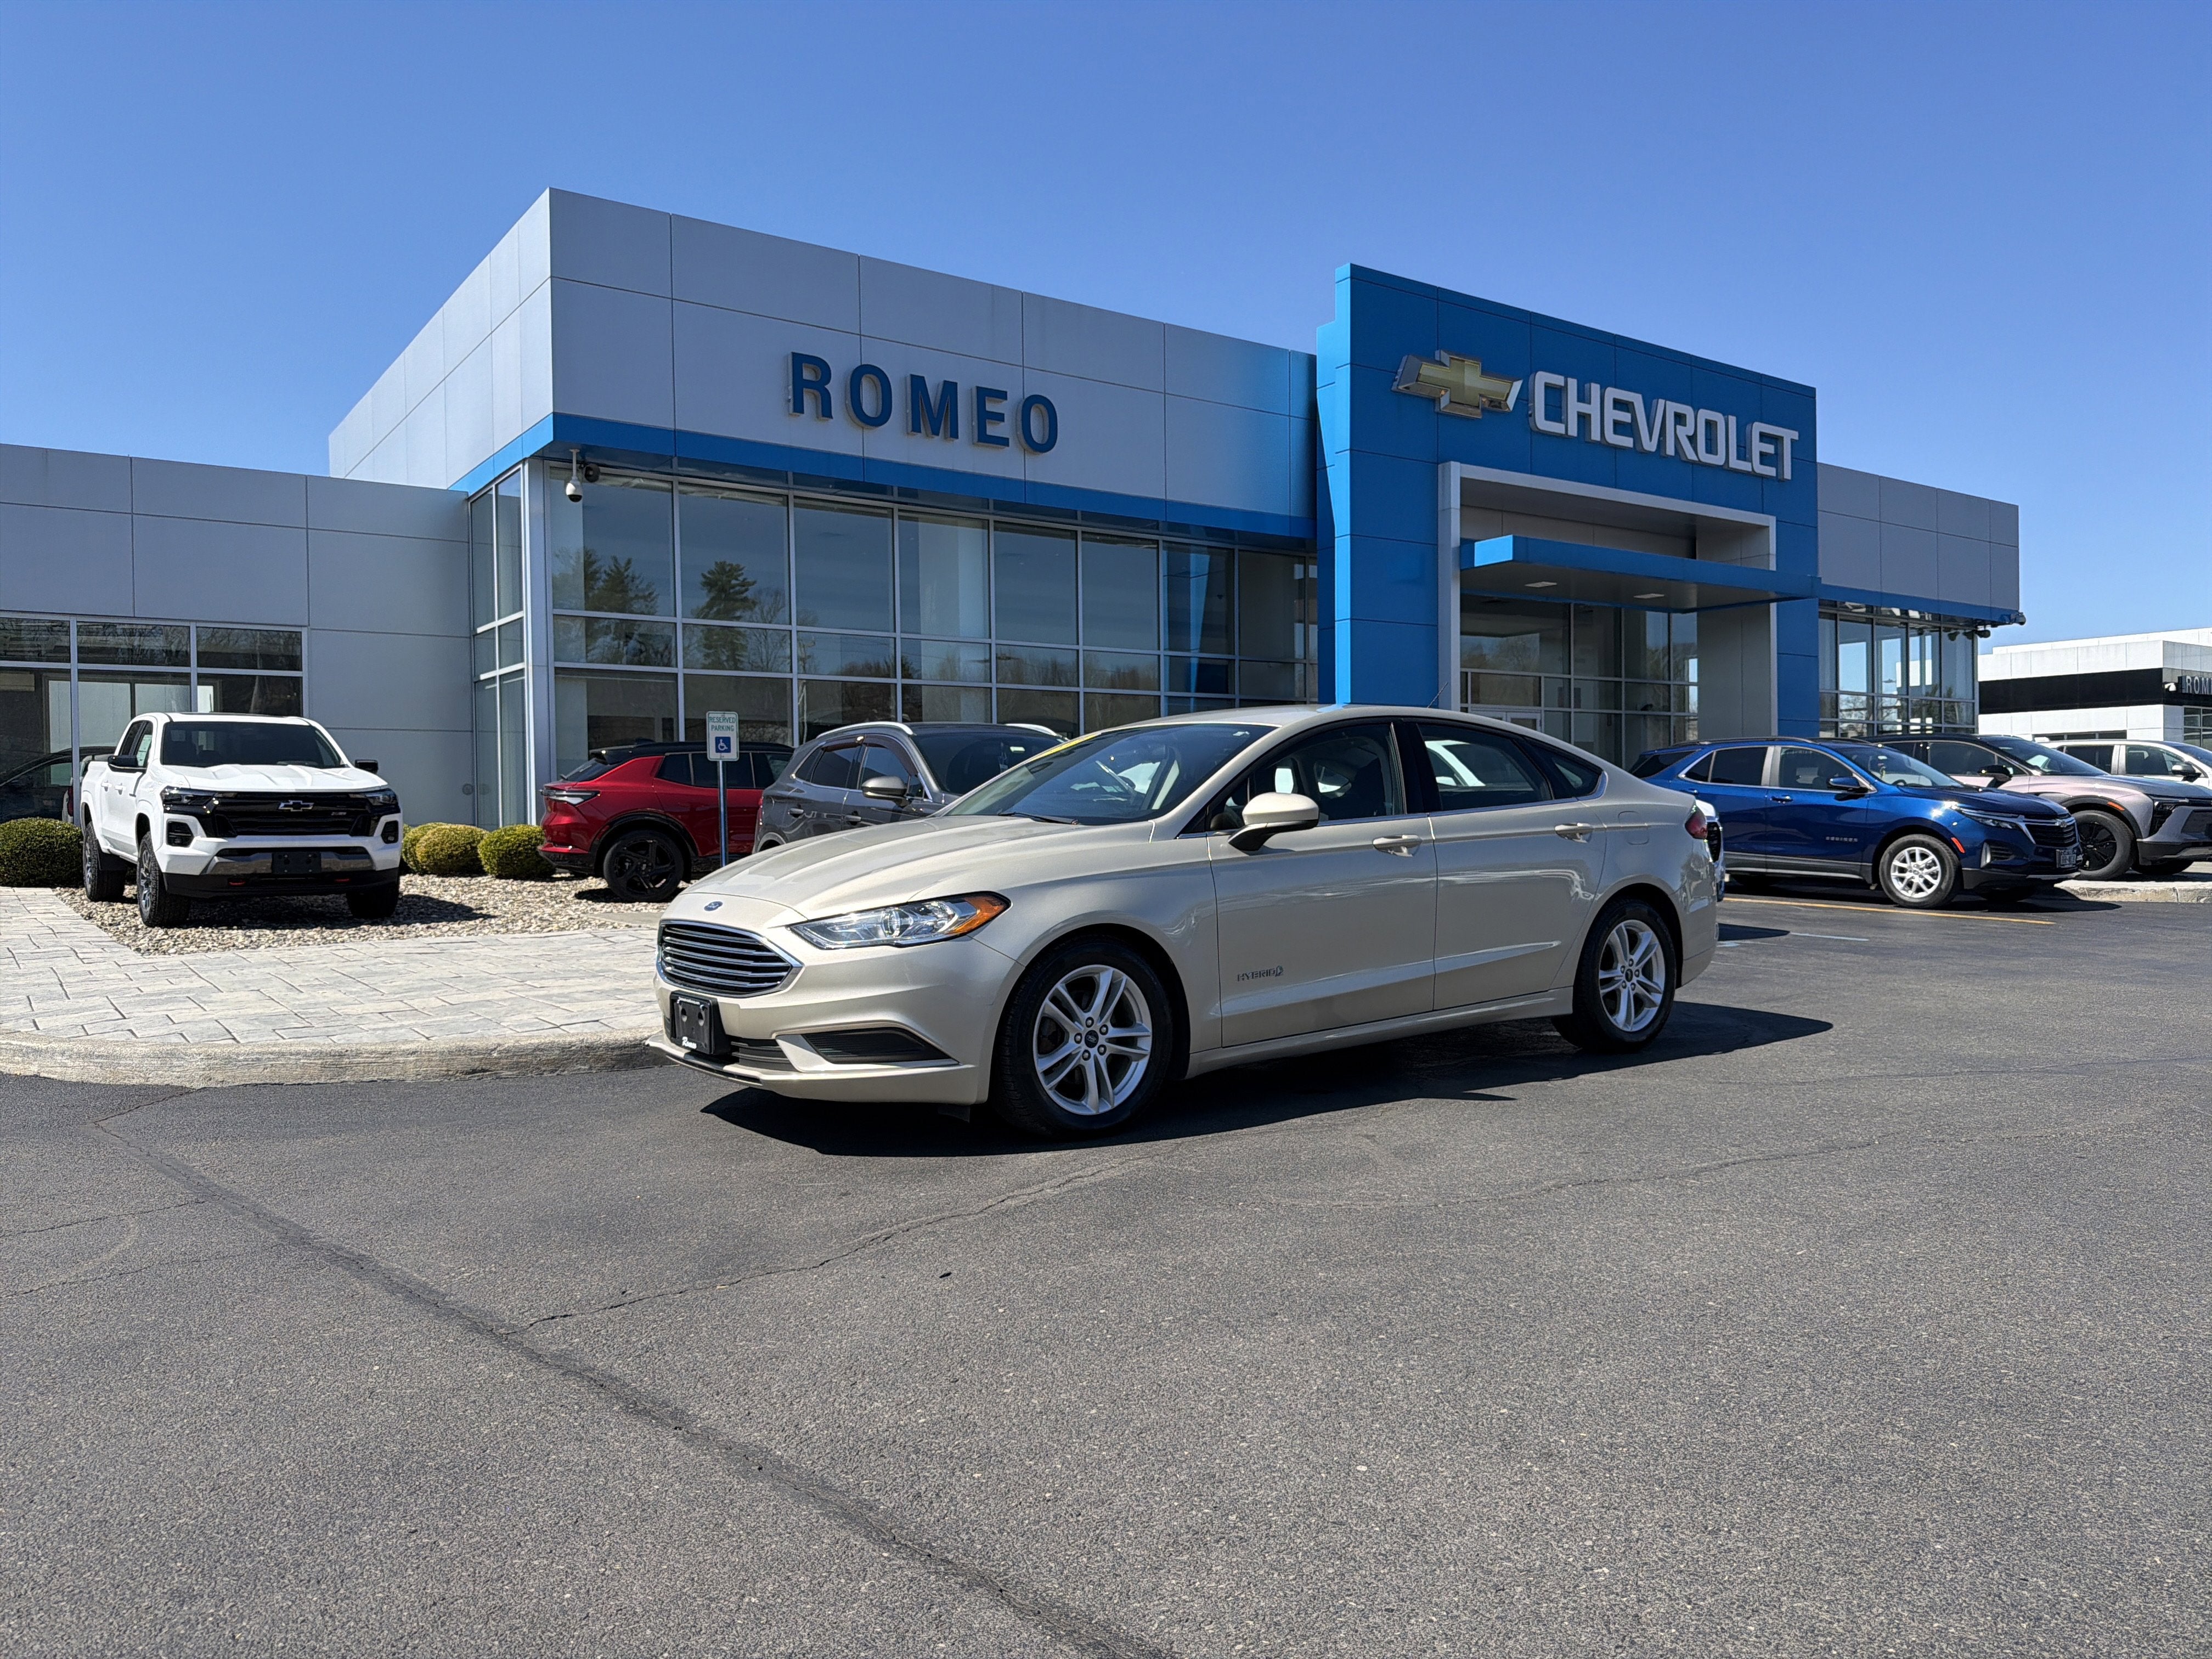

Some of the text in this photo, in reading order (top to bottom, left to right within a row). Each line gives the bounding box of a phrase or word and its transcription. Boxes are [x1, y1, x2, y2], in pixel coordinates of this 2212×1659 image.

[788, 352, 1058, 454] ROMEO
[1529, 371, 1799, 481] CHEVROLET
[1237, 968, 1276, 981] HYBRID
